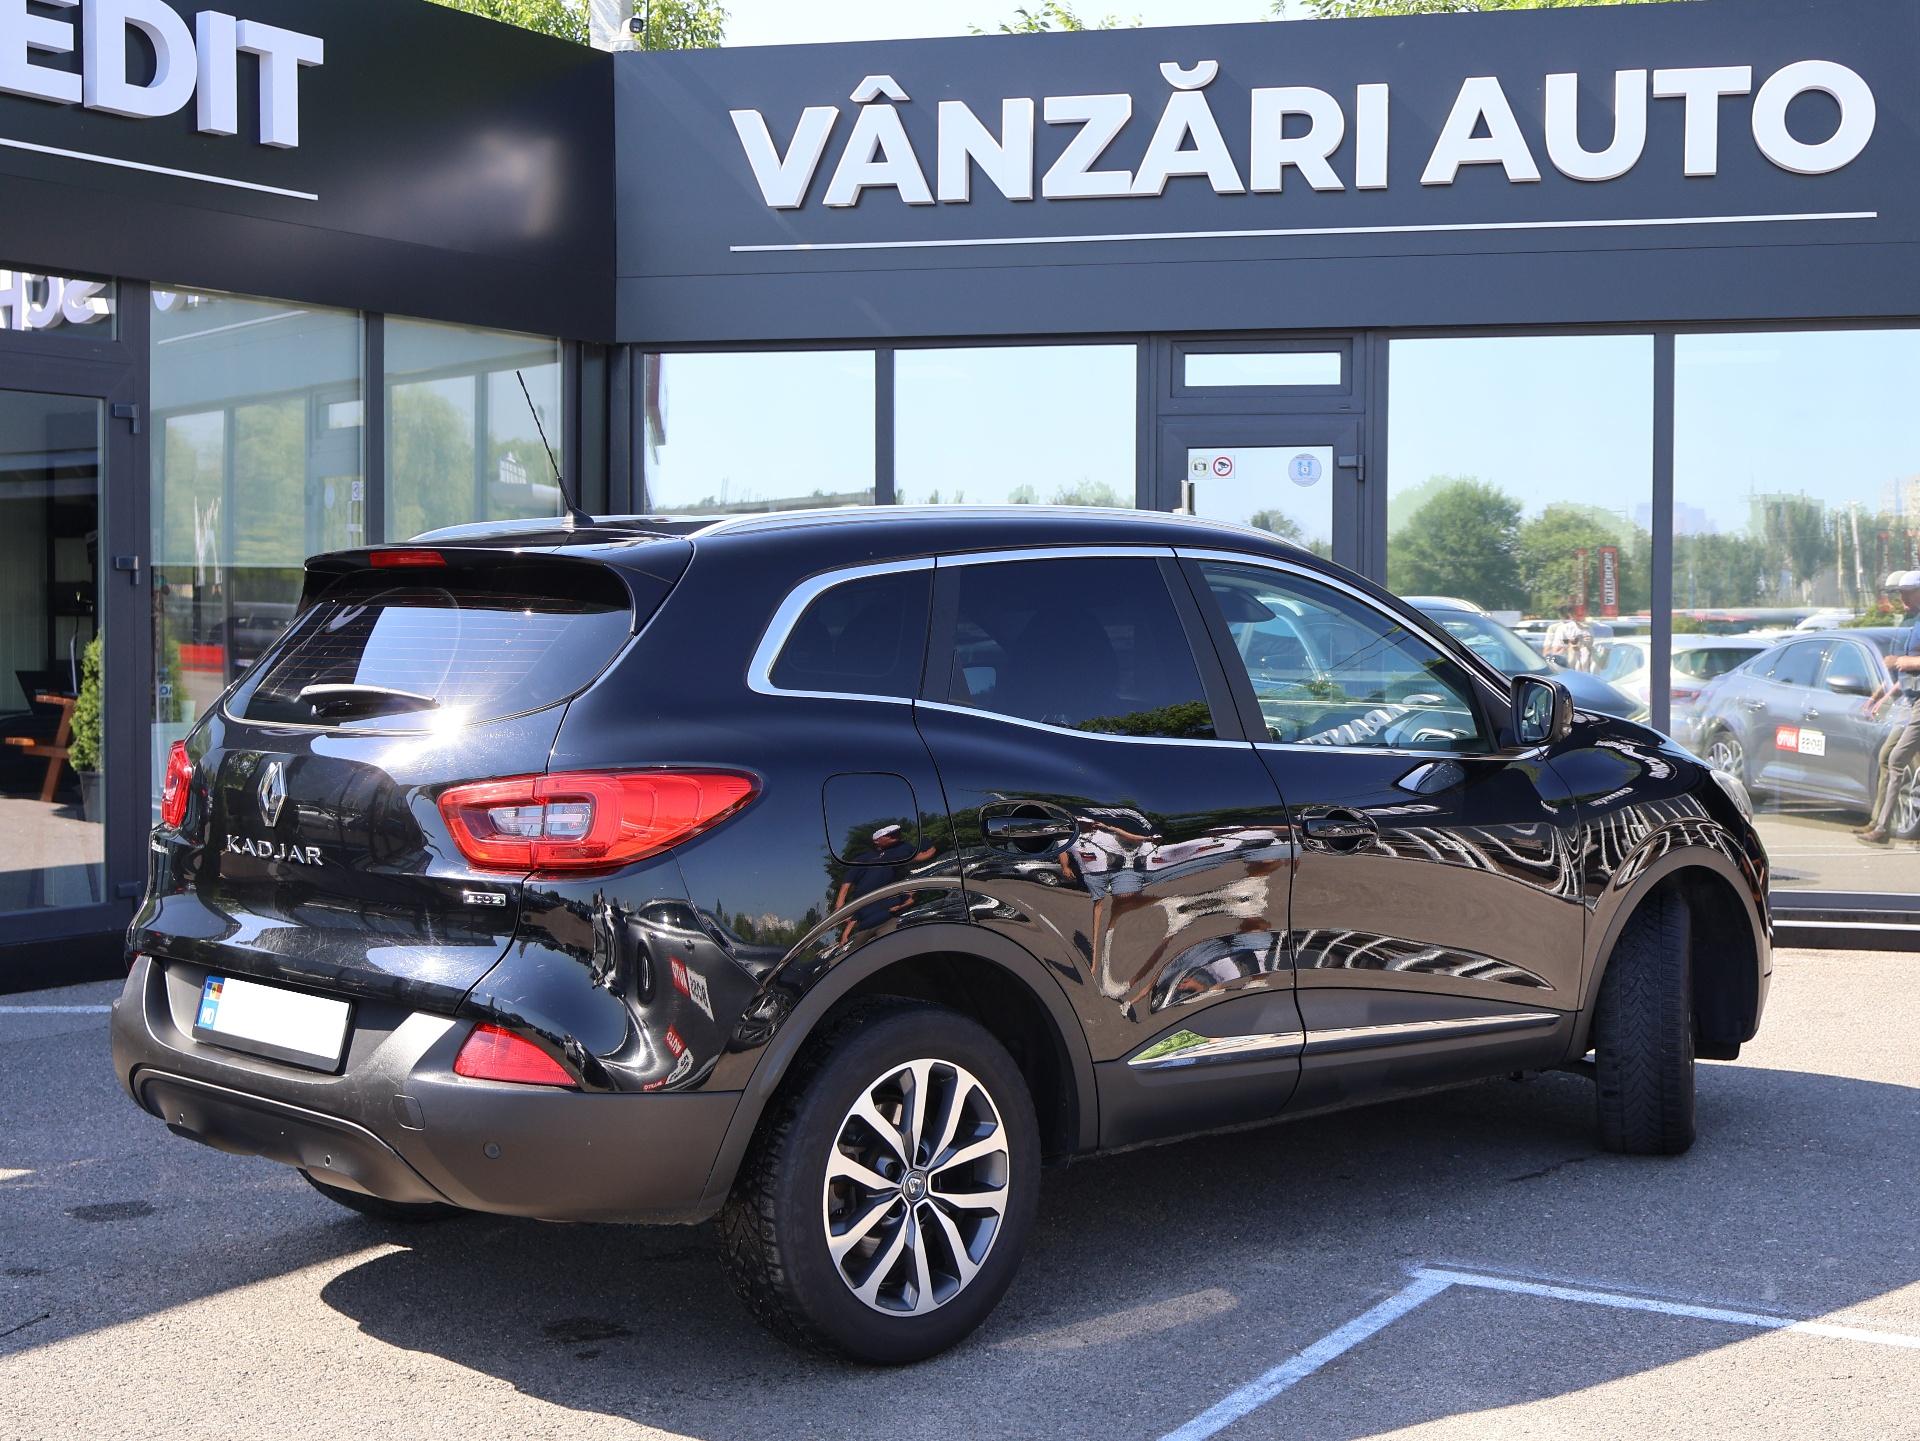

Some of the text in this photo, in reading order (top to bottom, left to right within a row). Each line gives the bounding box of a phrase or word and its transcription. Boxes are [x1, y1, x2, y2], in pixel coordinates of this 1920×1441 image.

[729, 59, 1877, 210] VÂNZĂRI AUTO
[226, 834, 324, 866] KADJAR
